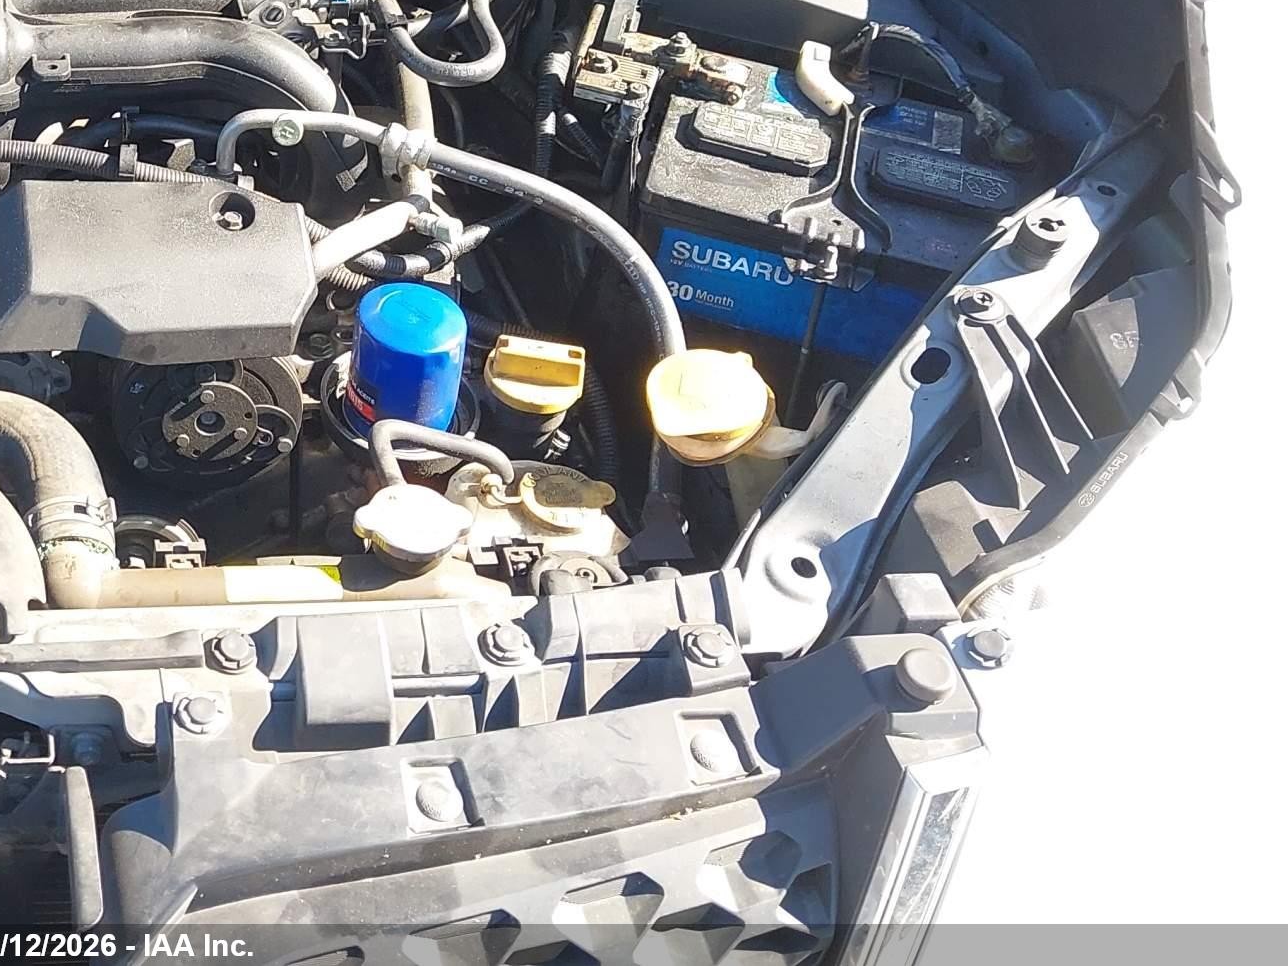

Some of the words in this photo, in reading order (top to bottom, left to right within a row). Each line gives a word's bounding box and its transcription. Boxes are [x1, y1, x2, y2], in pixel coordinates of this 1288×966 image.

[671, 240, 794, 286] SUBARU
[695, 288, 735, 308] Month
[1090, 451, 1129, 494] SUBARU
